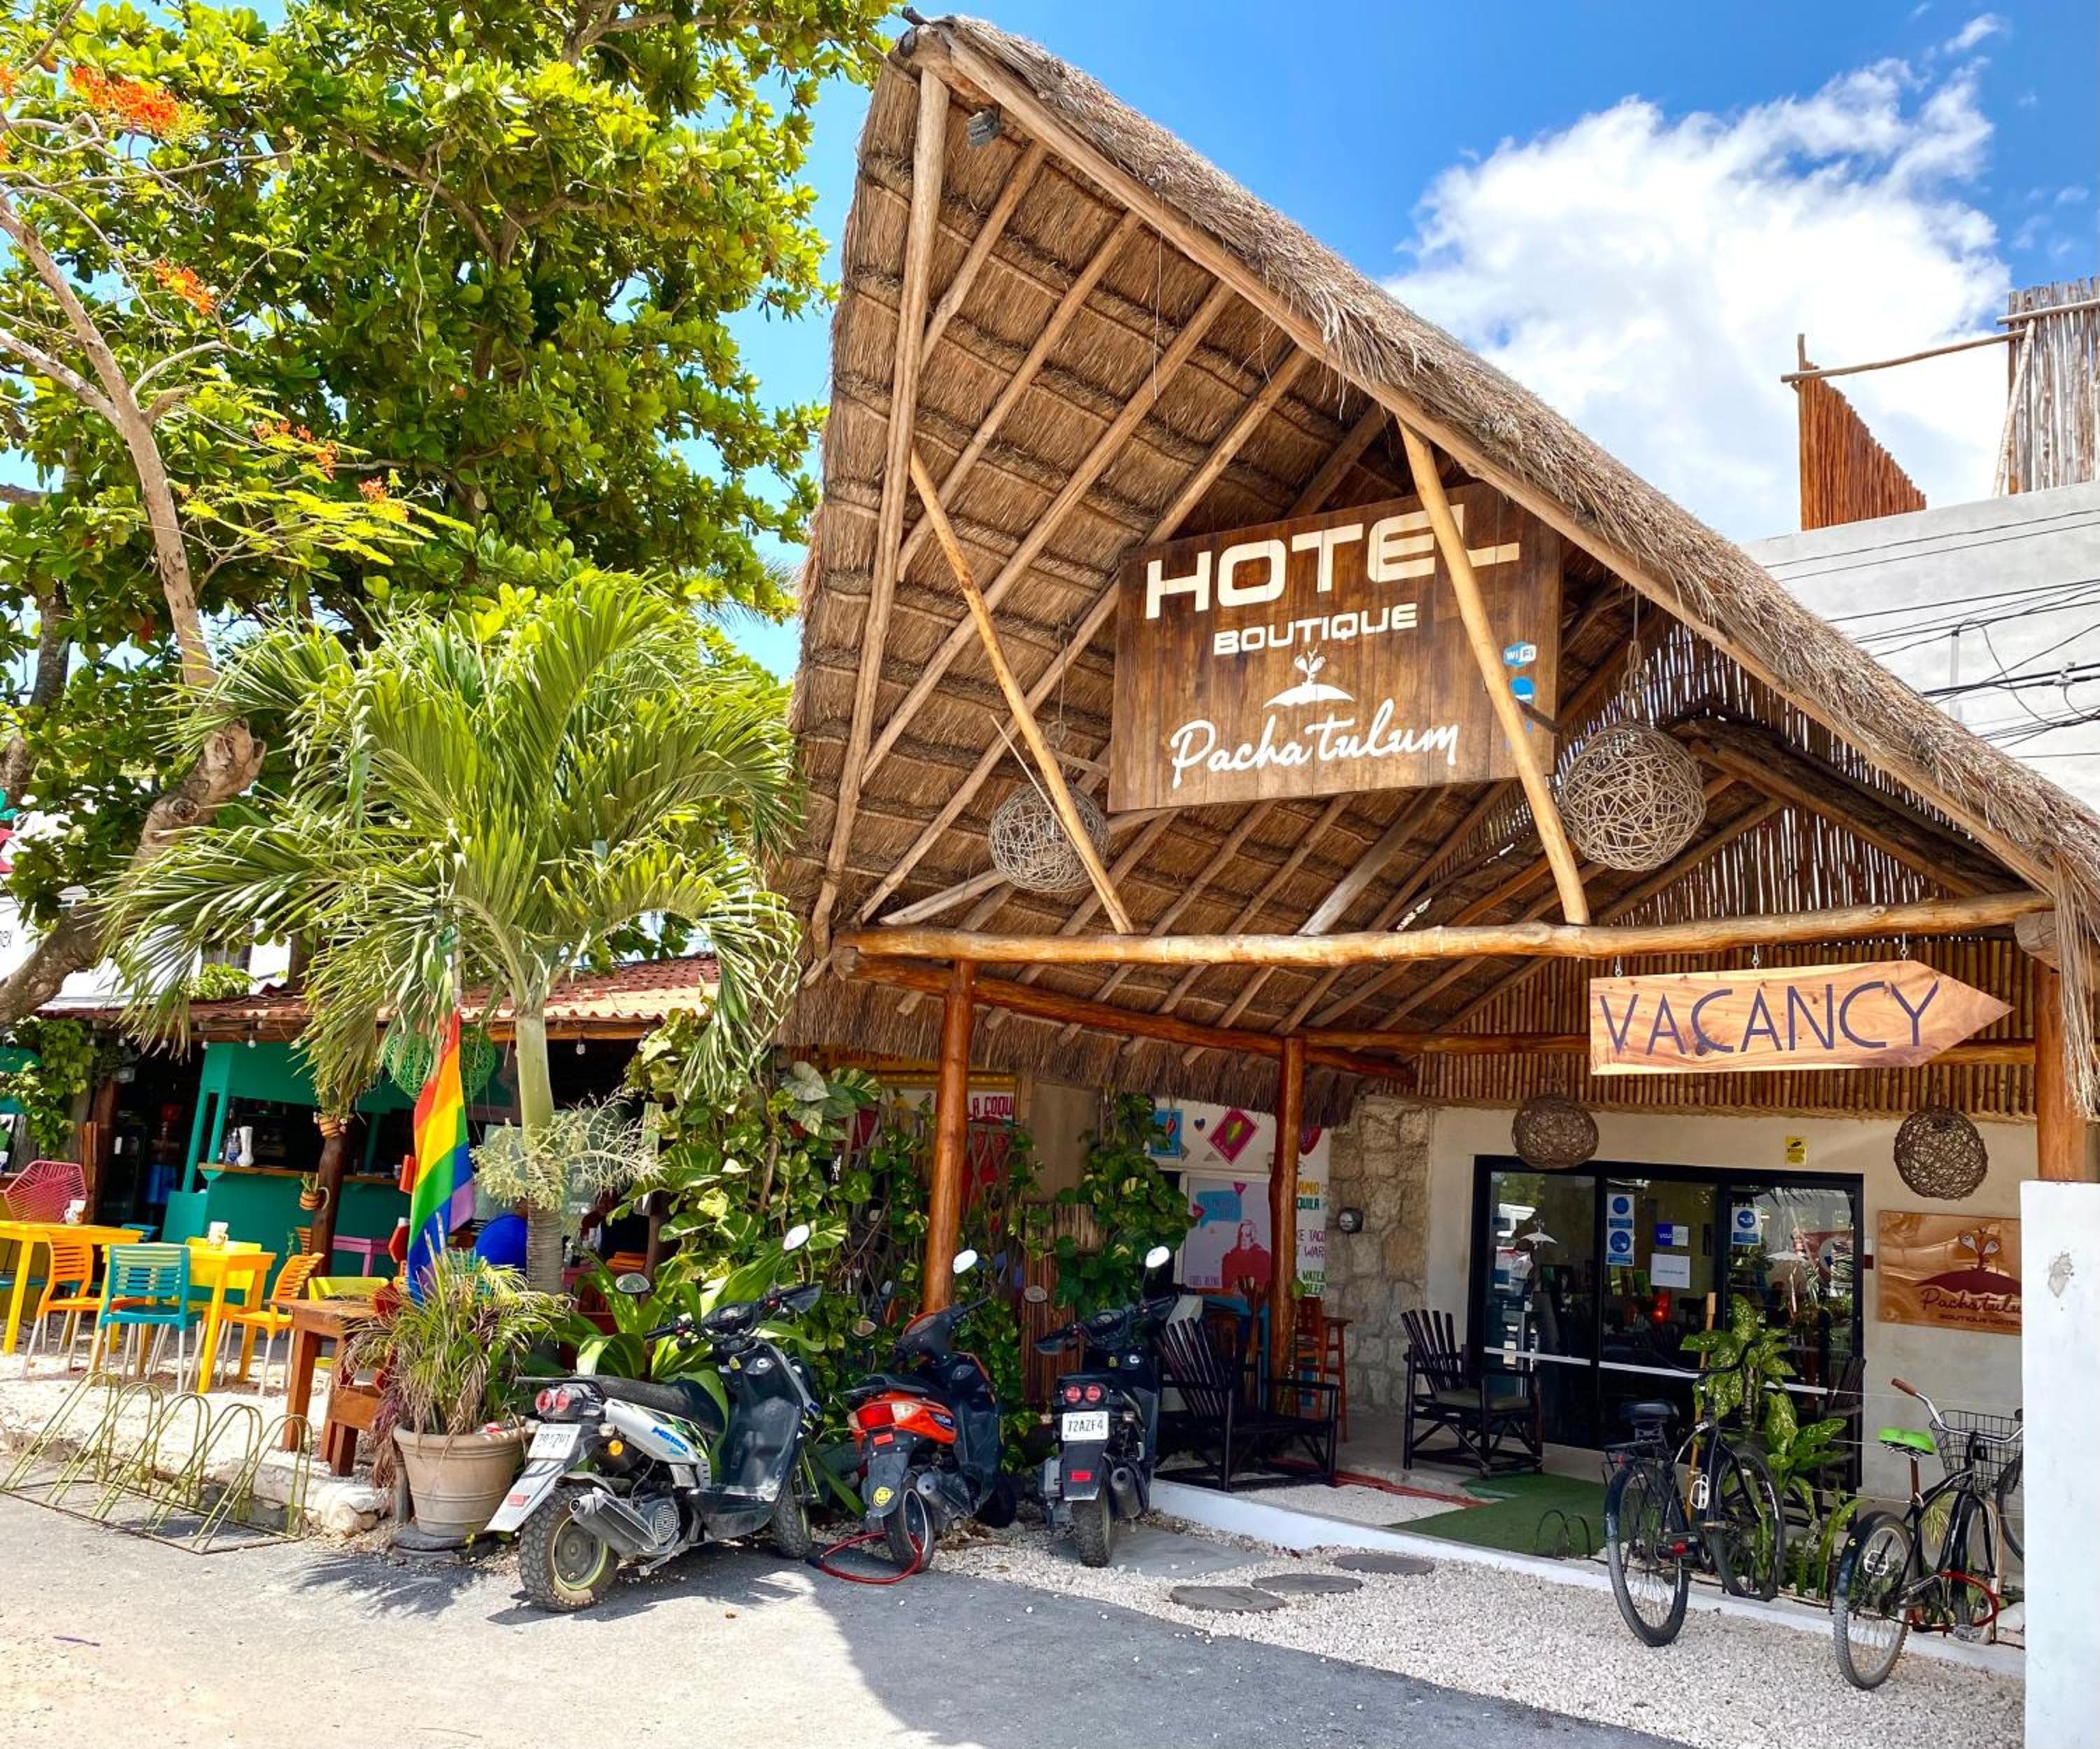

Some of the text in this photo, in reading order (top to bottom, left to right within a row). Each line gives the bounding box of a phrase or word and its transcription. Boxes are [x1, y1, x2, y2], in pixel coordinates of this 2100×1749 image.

[1146, 503, 1520, 620] HOTEL
[1213, 603, 1418, 655] BOUTIQUE
[1600, 980, 1940, 1055] VACANCY
